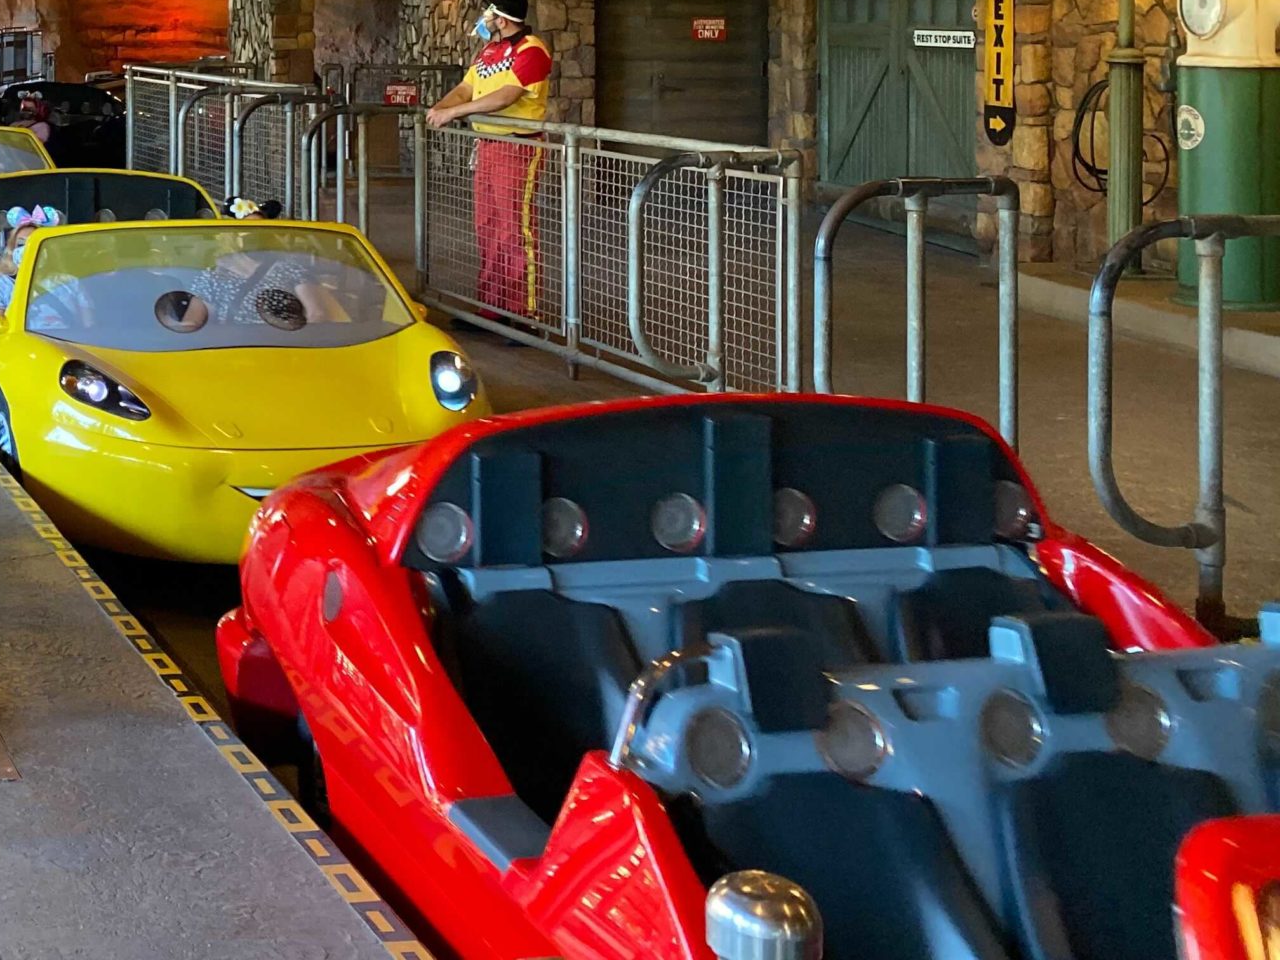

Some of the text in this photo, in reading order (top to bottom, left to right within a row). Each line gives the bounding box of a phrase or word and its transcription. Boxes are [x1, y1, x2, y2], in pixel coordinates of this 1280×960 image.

[697, 29, 720, 39] ONLY
[916, 34, 972, 45] REST STOP SUITE
[390, 94, 411, 104] ONLY
